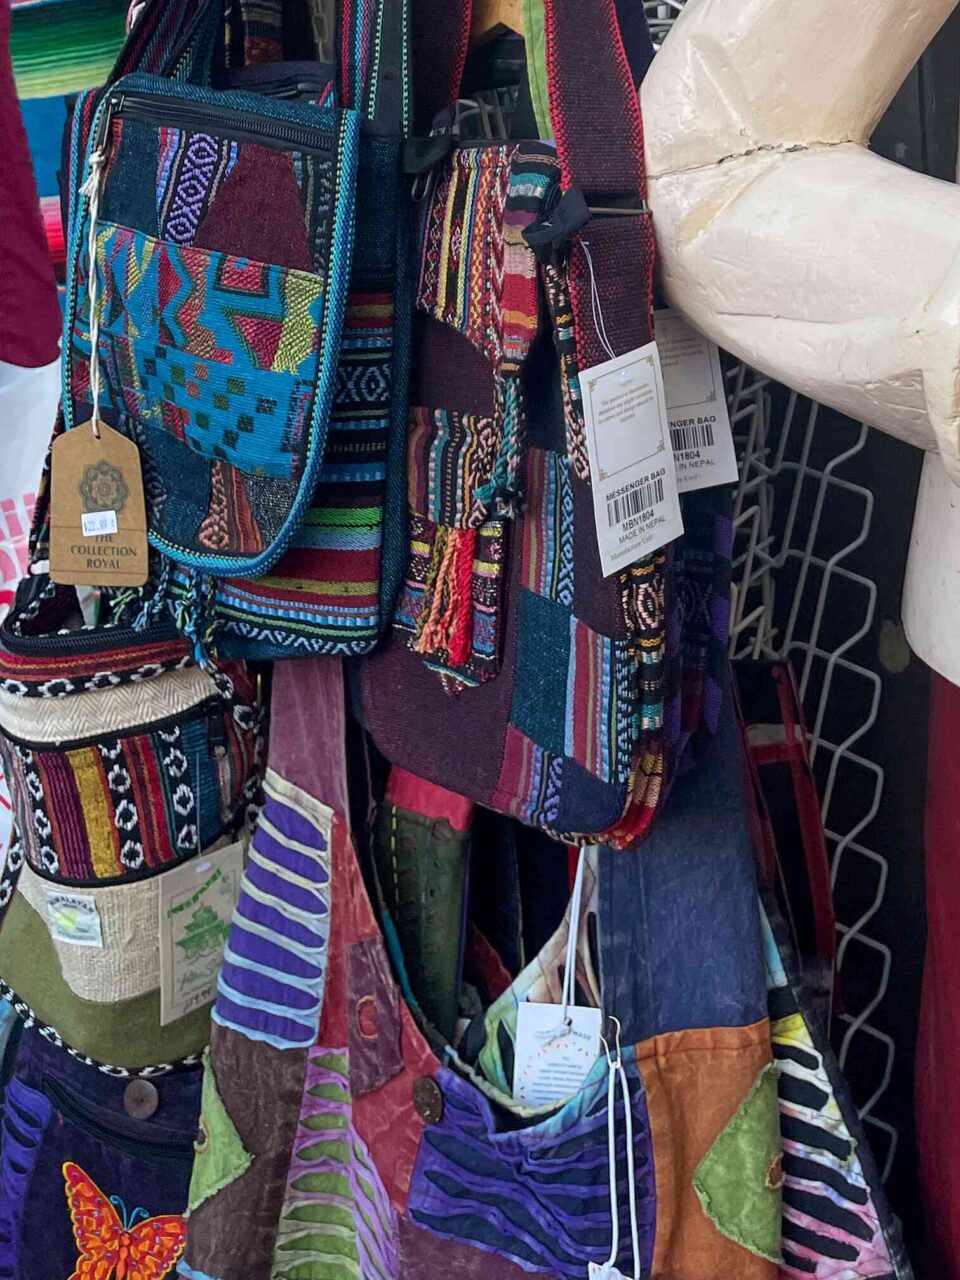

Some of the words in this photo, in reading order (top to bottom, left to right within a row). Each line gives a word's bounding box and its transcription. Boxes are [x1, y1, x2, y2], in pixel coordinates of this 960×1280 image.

[669, 418, 695, 428] NGER
[697, 415, 717, 425] BAG
[673, 450, 701, 462] N1804
[689, 459, 716, 469] NEPAL
[606, 476, 650, 502] MESSENGER
[650, 467, 666, 481] BAG
[622, 508, 655, 532] MBN1804
[618, 530, 637, 544] MADE
[638, 525, 645, 534] IN
[646, 515, 666, 529] NEPAL
[70, 544, 137, 557] COLLECTION
[86, 558, 121, 569] ROYAL
